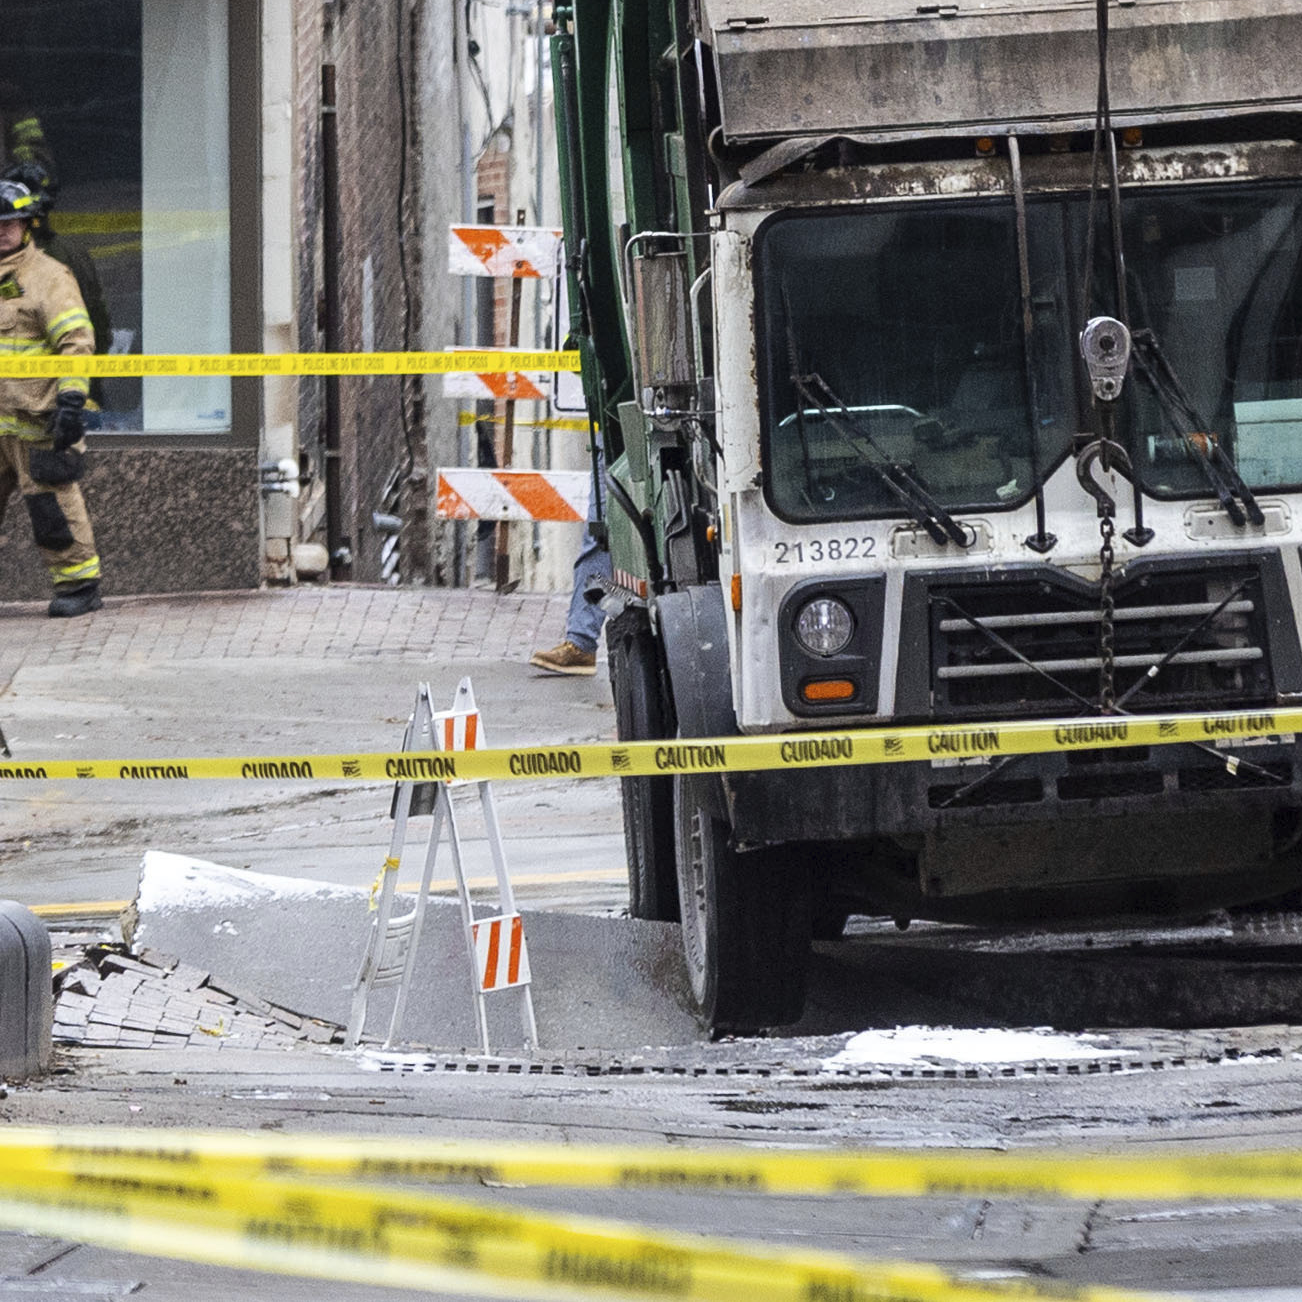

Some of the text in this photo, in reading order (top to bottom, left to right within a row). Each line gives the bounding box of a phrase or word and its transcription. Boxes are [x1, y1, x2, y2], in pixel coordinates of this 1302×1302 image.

[774, 536, 877, 565] 213822
[385, 757, 457, 778] CAUTION
[510, 751, 582, 776] CUIDADO
[655, 745, 727, 770] CAUTION
[781, 737, 853, 763] CUIDADO
[928, 731, 1001, 754] CAUTION
[1055, 723, 1128, 745] CUIDADO
[1203, 714, 1276, 735] CAUTION
